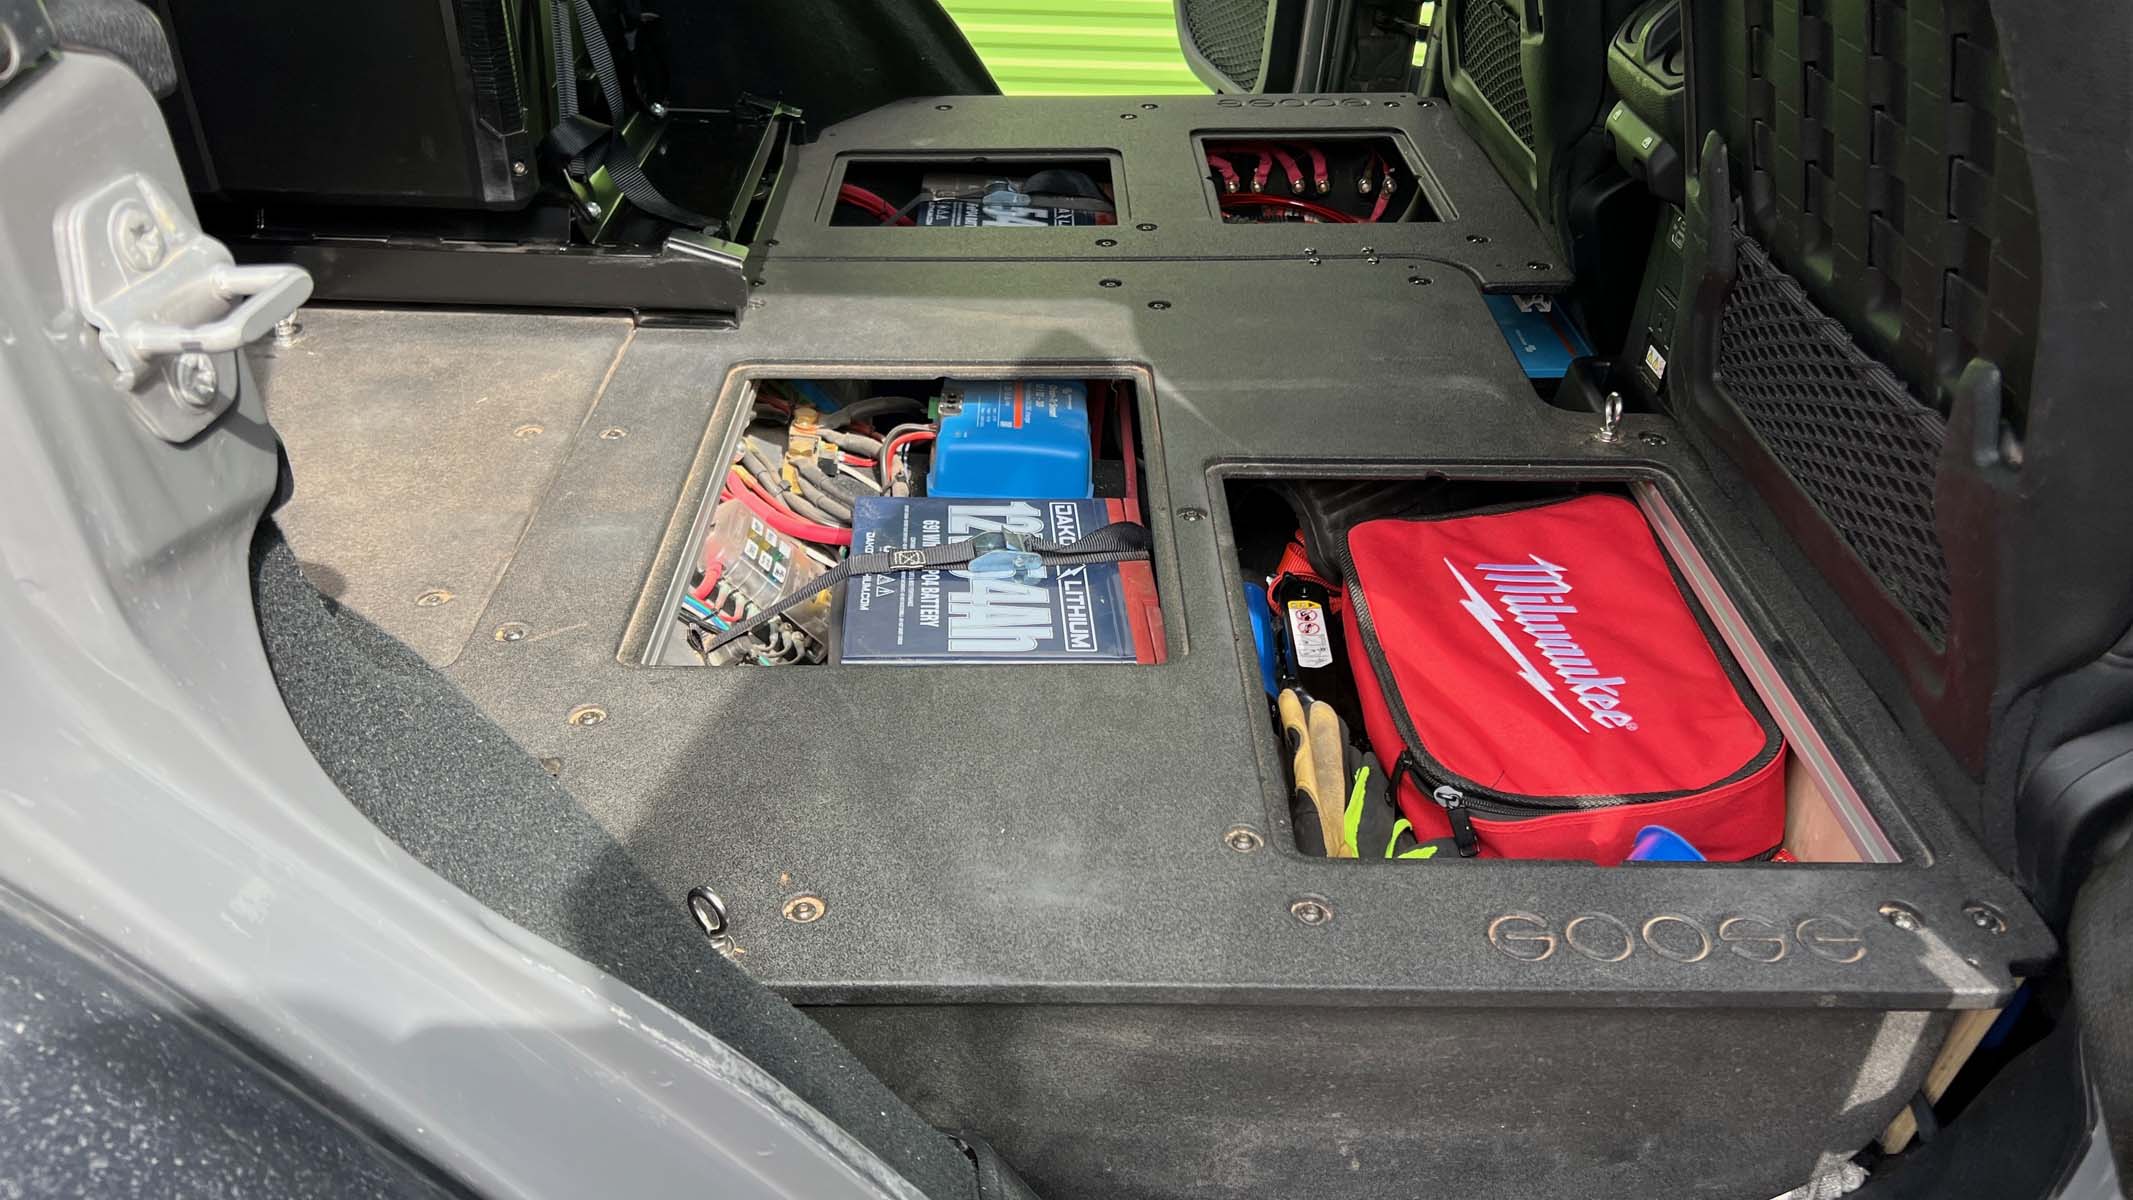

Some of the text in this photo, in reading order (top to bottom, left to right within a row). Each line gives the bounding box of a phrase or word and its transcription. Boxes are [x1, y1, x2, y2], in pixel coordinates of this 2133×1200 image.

[922, 519, 941, 533] 691
[947, 501, 1045, 545] 12
[1054, 504, 1091, 649] DAKO LITHIUM
[919, 587, 940, 628] BATTERY
[1474, 553, 1634, 730] Milwaukee
[1487, 909, 1869, 963] GOOSE
